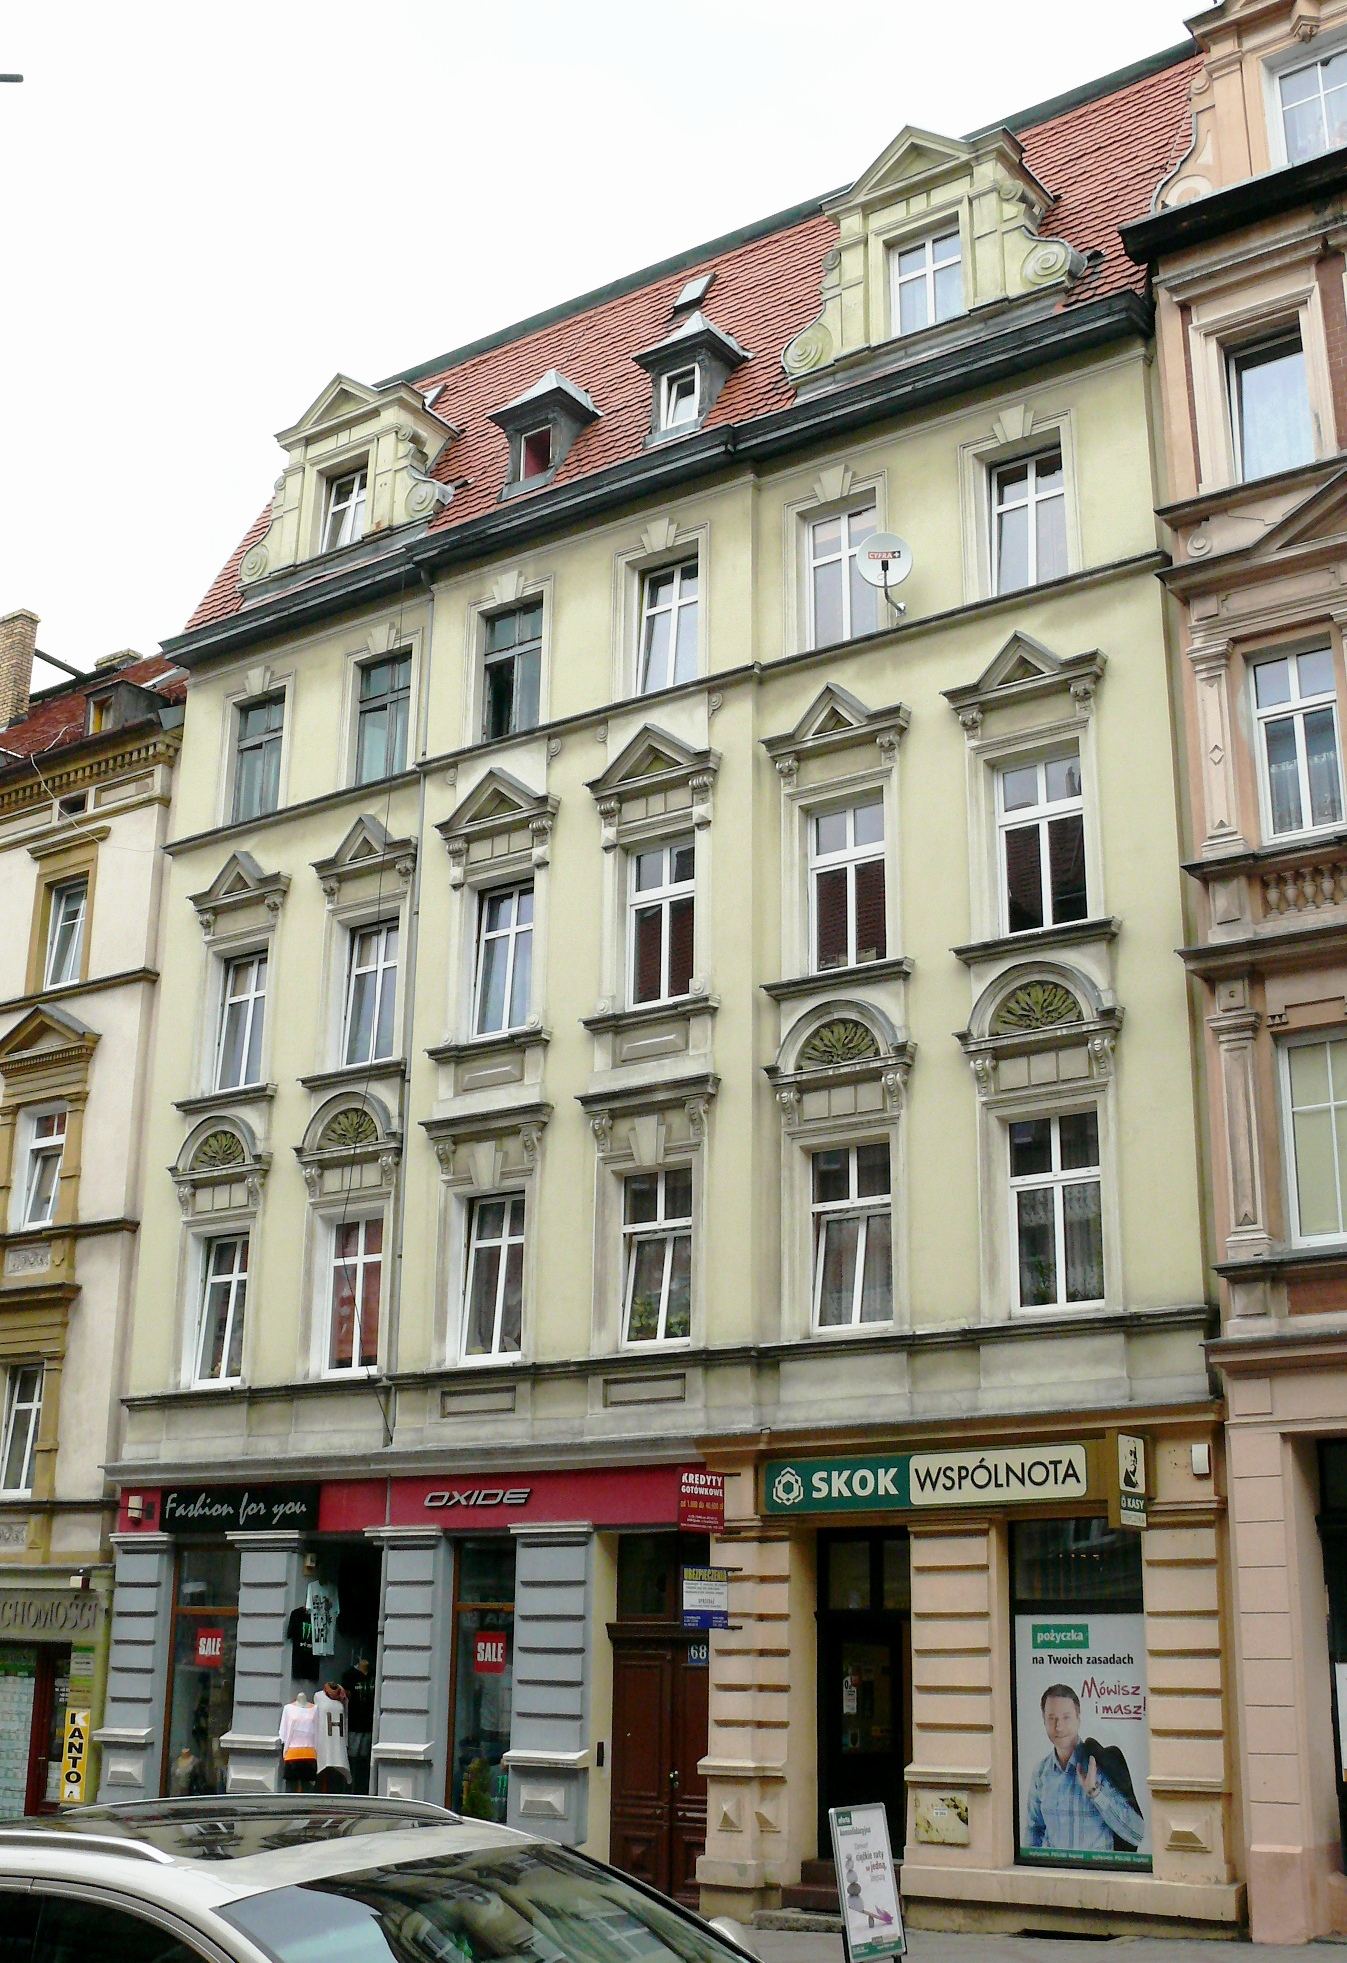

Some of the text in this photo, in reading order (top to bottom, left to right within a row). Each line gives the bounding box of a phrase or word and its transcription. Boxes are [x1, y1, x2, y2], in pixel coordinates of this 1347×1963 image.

[681, 1472, 723, 1487] KREDYTY
[811, 1457, 1081, 1499] SKOK WSPÓLNOTA
[424, 1487, 531, 1507] OXIDE
[681, 1484, 723, 1497] GOTÓWKOWE
[165, 1492, 307, 1526] Fashion for you
[1037, 1629, 1084, 1643] pożyczka
[198, 1637, 222, 1656] SALE
[476, 1642, 503, 1662] SALE
[690, 1644, 708, 1660] 68
[1032, 1653, 1134, 1665] na Twoich zasadach
[1080, 1676, 1141, 1699] Mówisz
[1095, 1701, 1099, 1715] i
[327, 1711, 344, 1738] H
